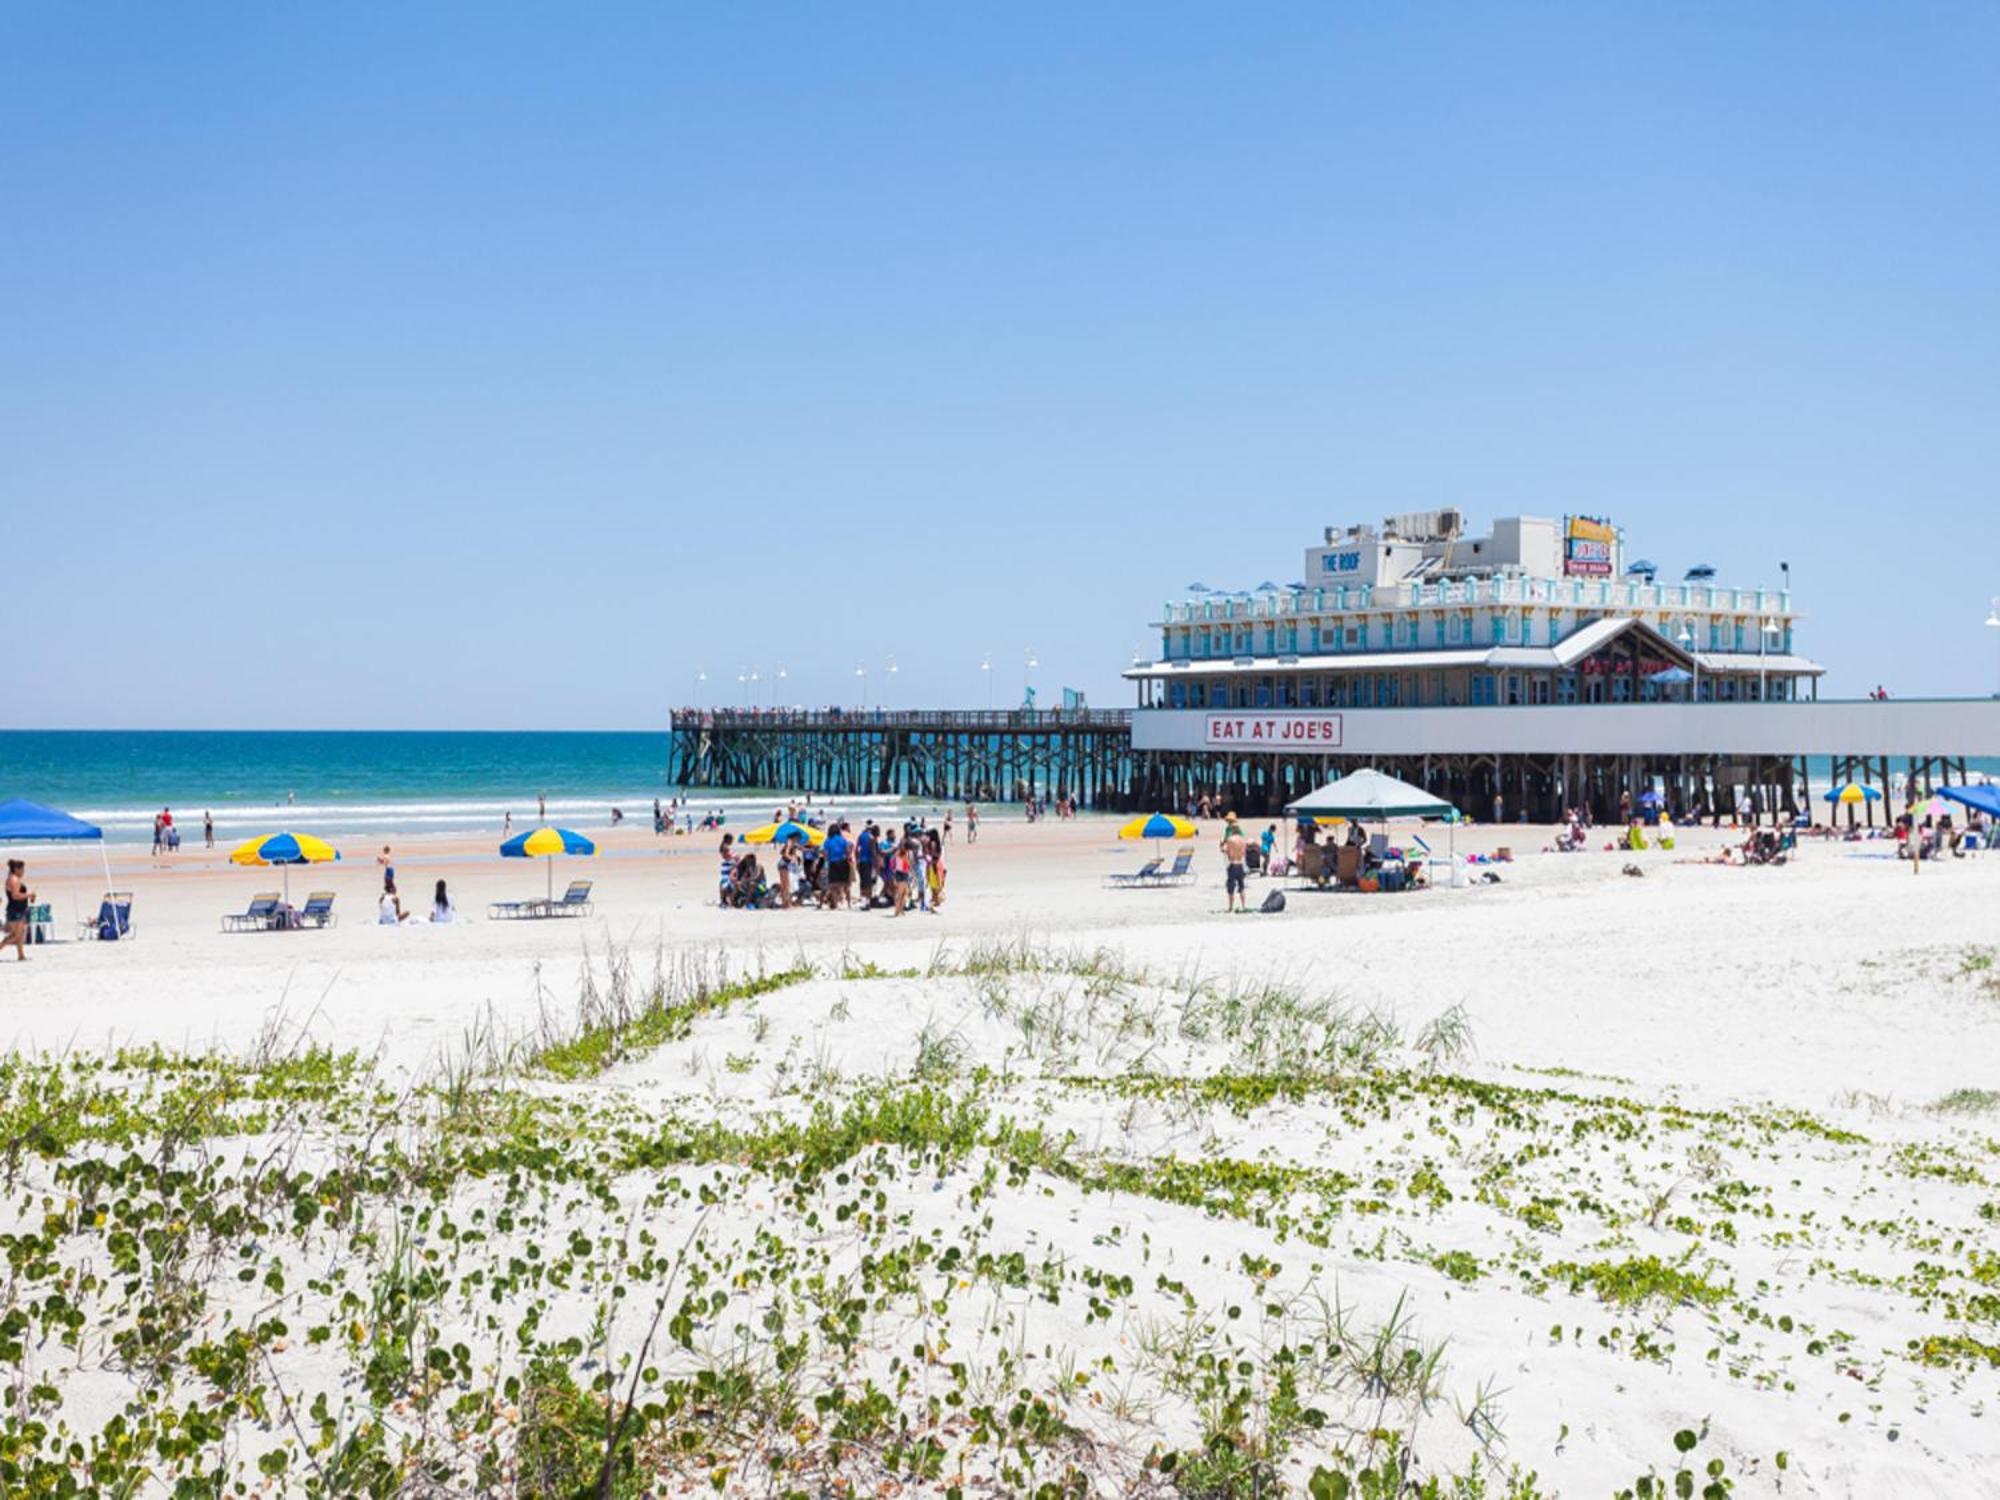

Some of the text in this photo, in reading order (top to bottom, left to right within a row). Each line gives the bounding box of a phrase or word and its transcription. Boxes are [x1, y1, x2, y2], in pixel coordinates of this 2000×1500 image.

[1322, 551, 1361, 572] THE ROOF
[1212, 721, 1334, 739] EAT AT JOE'S
